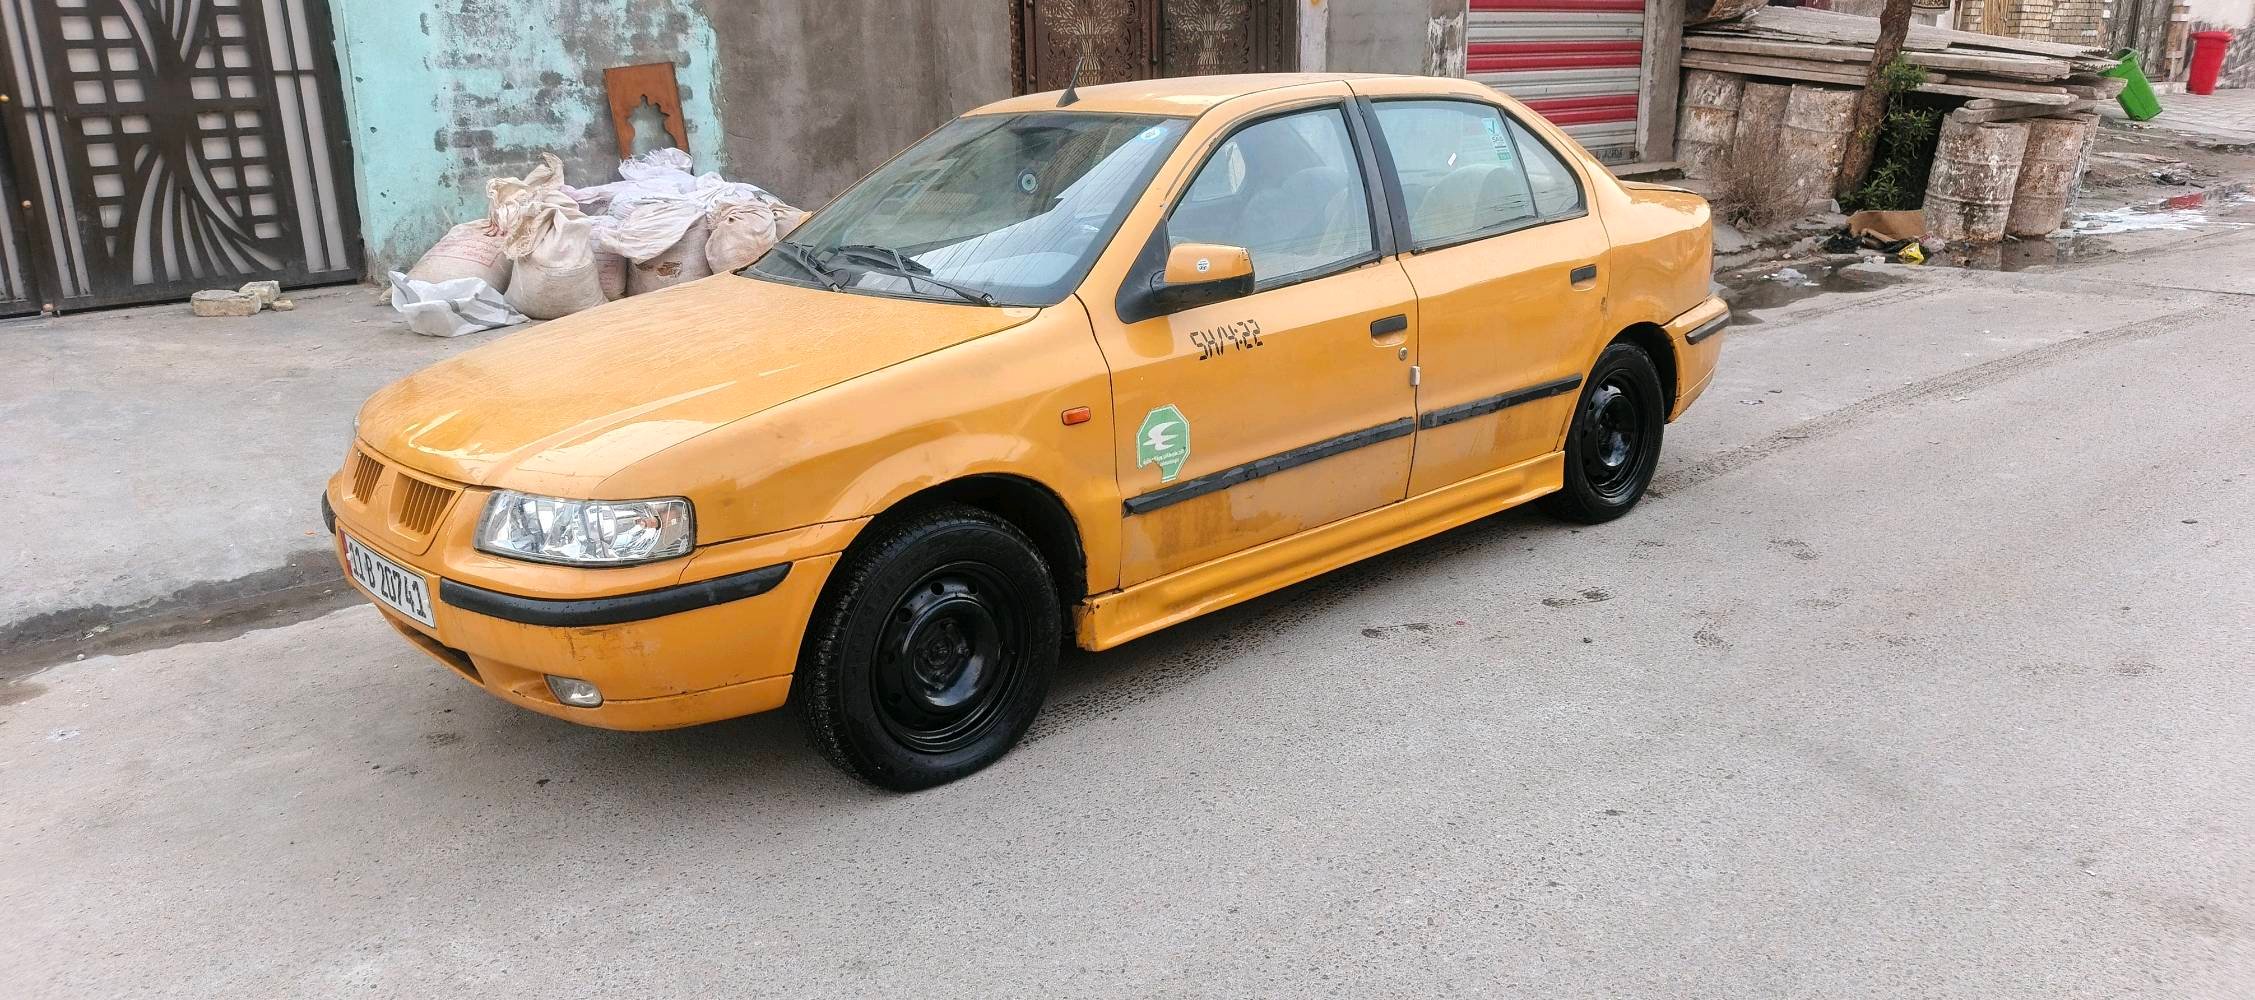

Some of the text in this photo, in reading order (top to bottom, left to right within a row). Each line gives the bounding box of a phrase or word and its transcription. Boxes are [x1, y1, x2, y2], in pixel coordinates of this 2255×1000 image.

[349, 542, 427, 618] 11 B 20741
